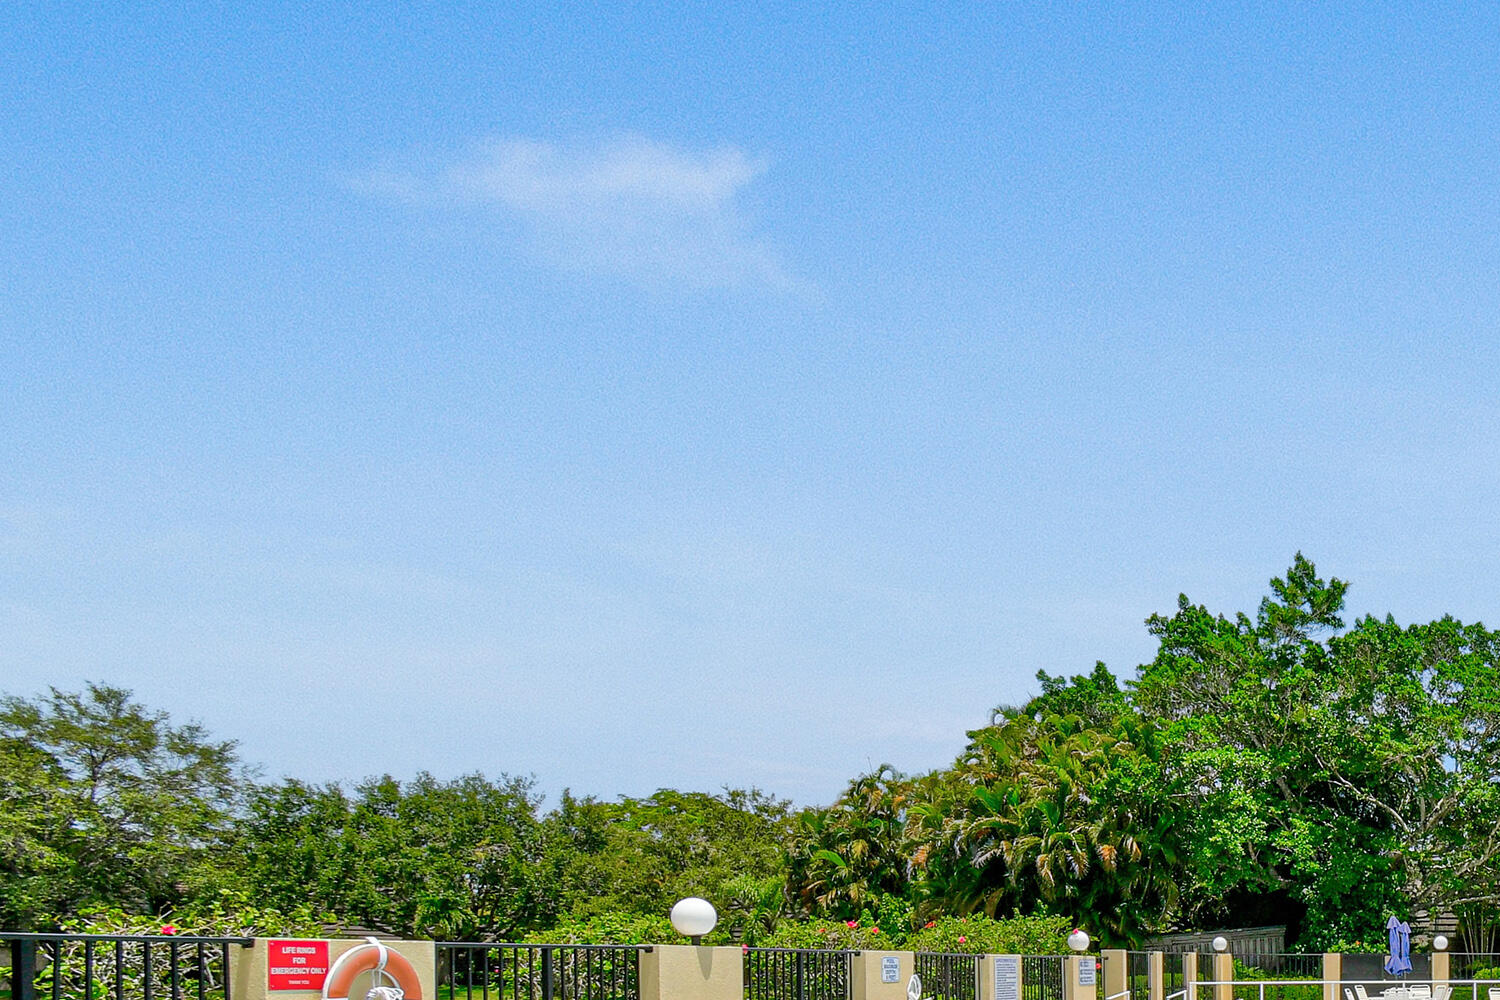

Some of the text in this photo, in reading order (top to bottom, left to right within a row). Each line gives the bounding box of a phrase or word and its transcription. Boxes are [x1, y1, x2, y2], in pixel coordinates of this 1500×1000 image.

[282, 946, 316, 954] LIFE RINGS
[292, 956, 306, 965] FOR
[271, 967, 327, 975] EMERGENCY ONLY
